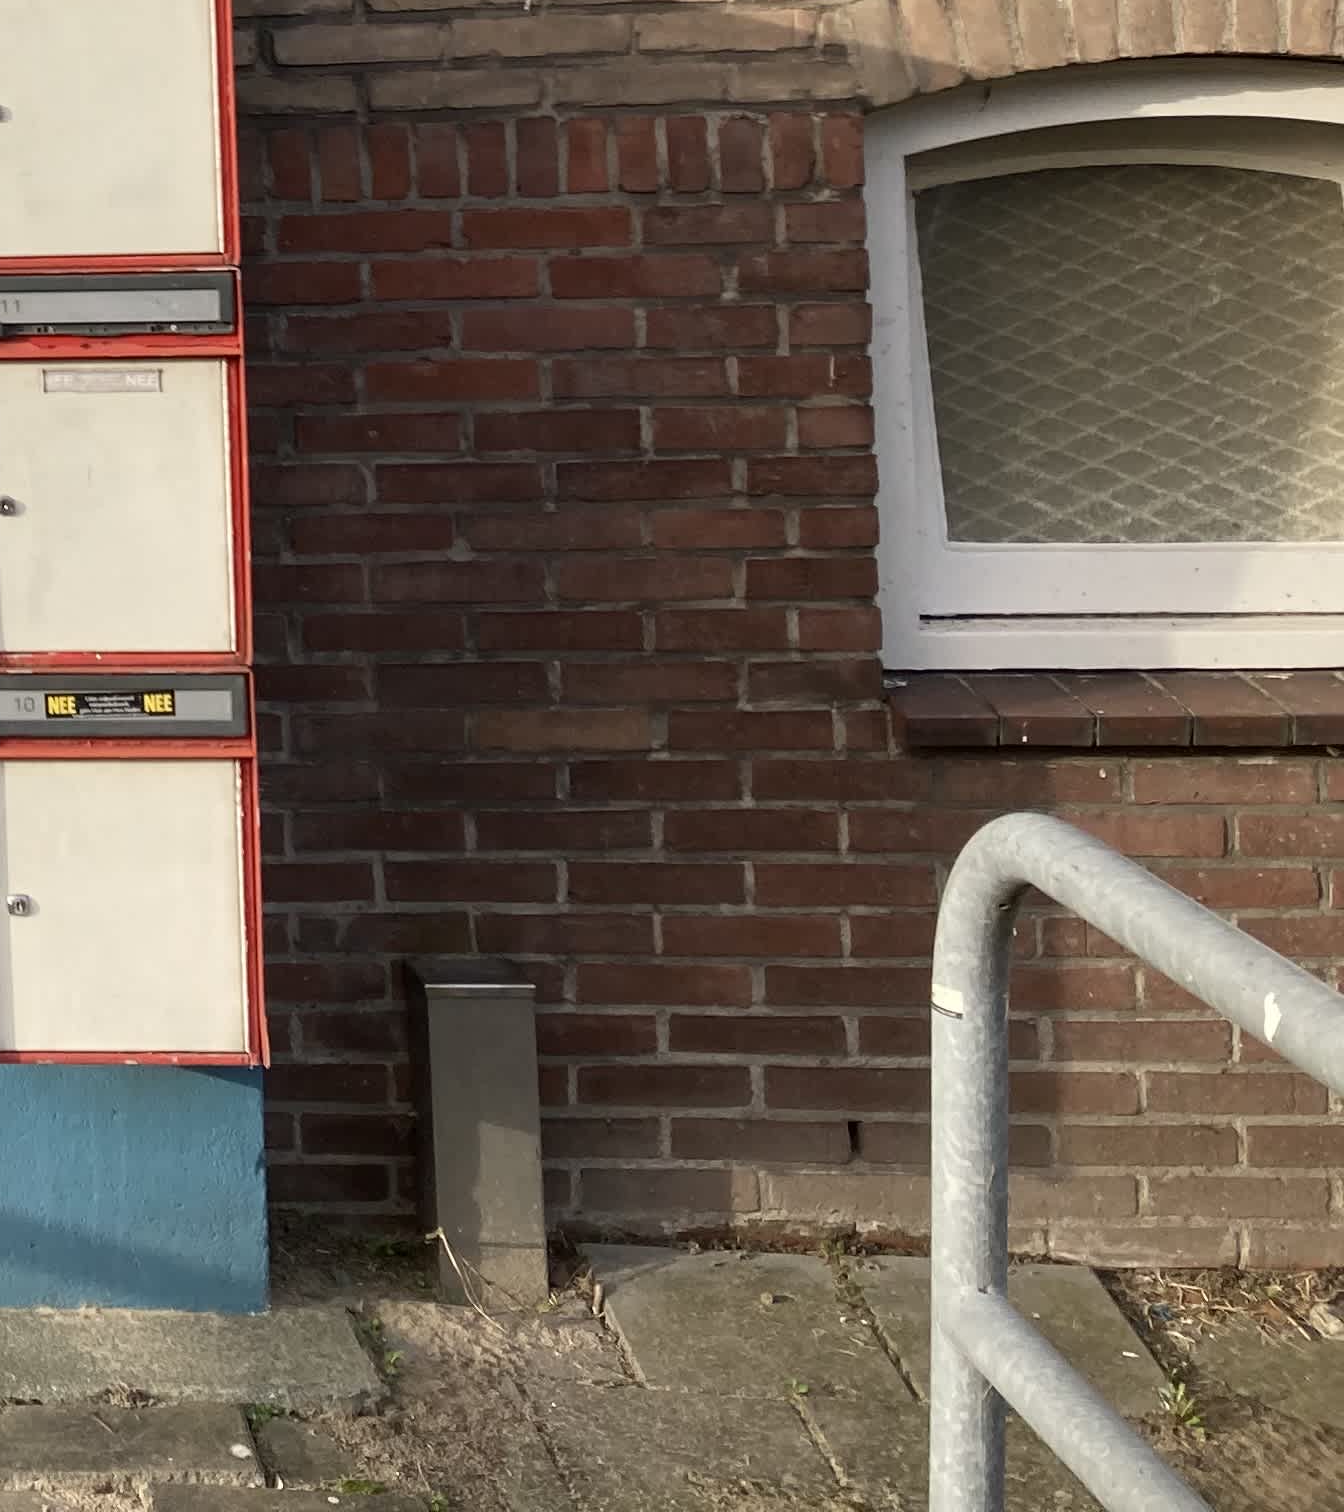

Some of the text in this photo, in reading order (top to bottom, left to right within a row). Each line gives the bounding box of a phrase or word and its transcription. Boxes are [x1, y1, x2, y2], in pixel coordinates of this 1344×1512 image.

[0, 299, 21, 313] 11
[14, 696, 35, 713] 10
[47, 695, 77, 715] NEE
[143, 693, 173, 713] NEE
